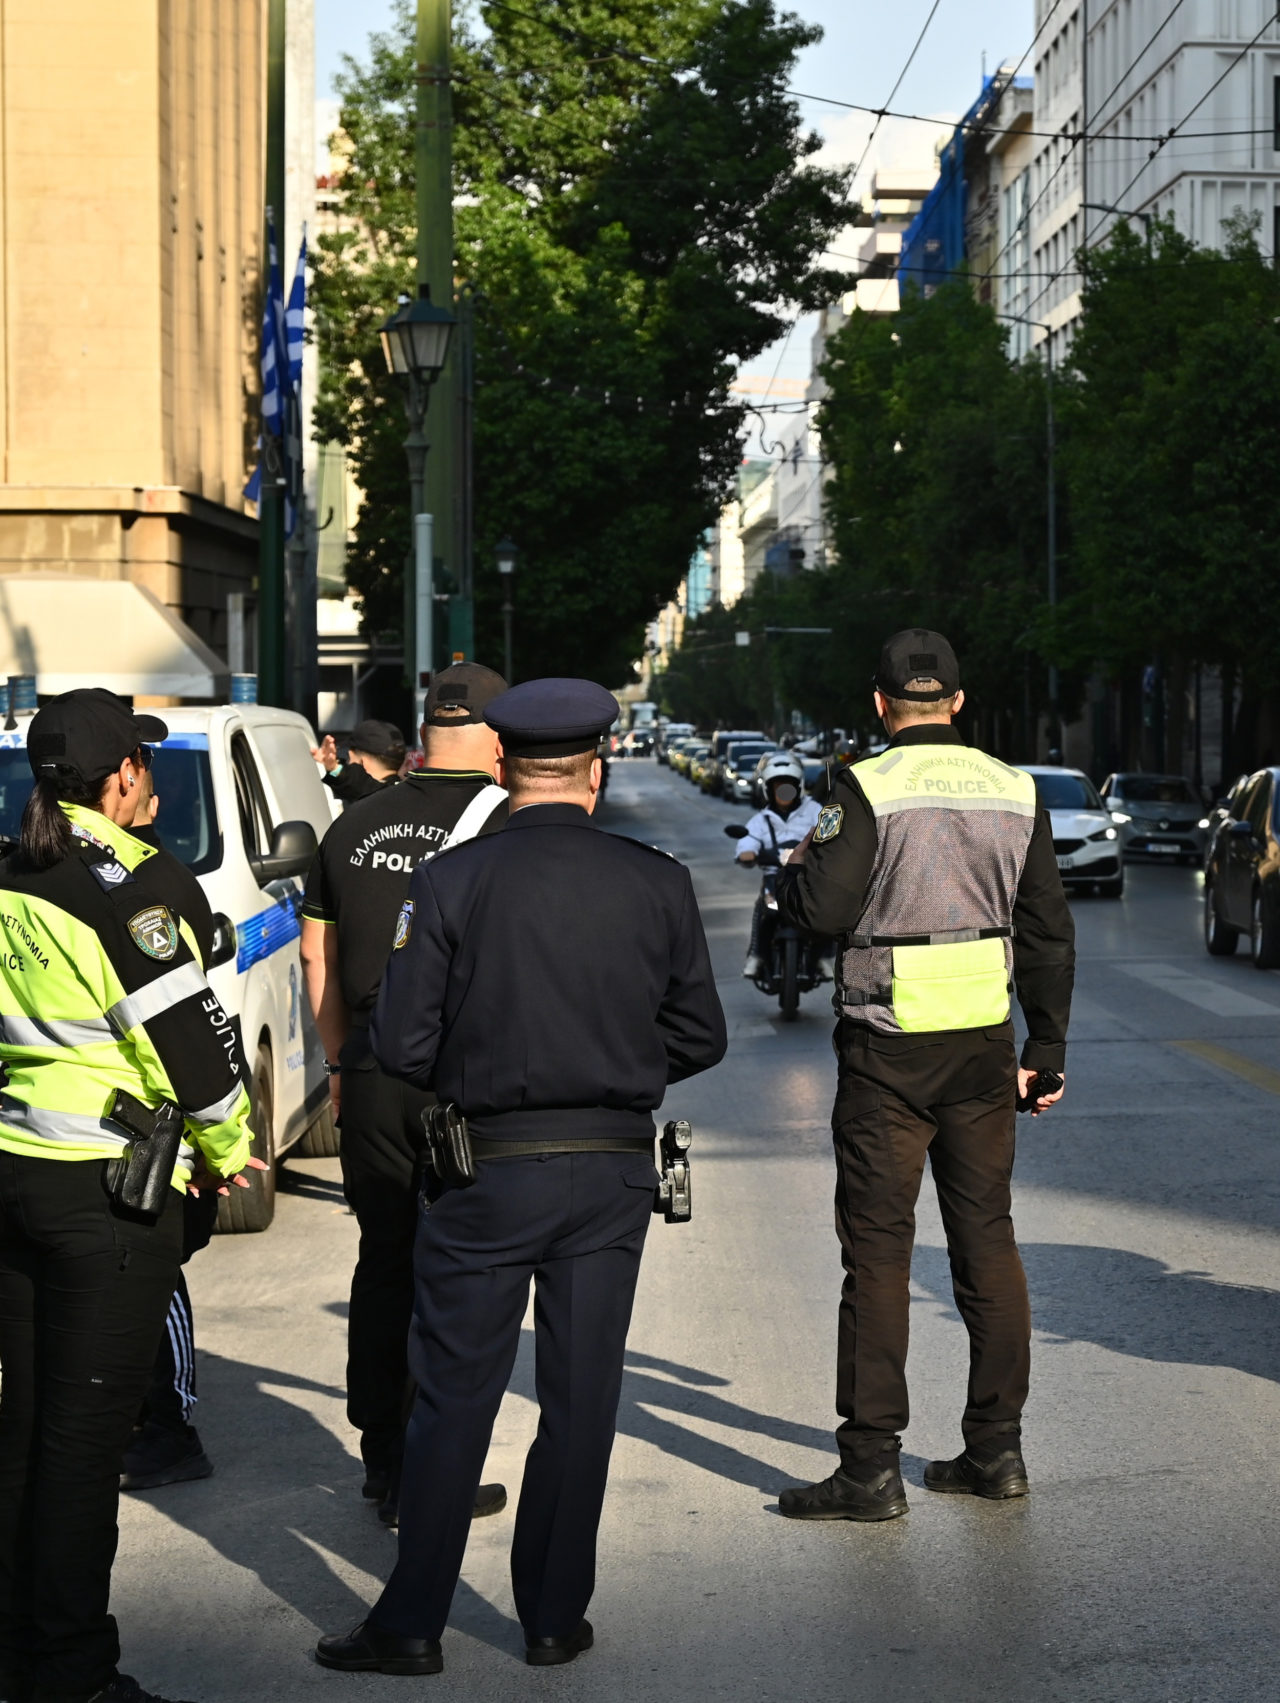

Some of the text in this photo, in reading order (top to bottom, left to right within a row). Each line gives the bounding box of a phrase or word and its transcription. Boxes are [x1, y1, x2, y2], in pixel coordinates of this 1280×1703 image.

[905, 758, 1006, 793] ΕΛΛΗΝΙΚΗ ΑΣΤΥΝΟΜΙΑ
[924, 779, 988, 793] POLICE
[350, 824, 413, 867] ΕΛΛΗΝΙΚΗ
[372, 851, 424, 873] POL
[0, 953, 25, 972] ICE
